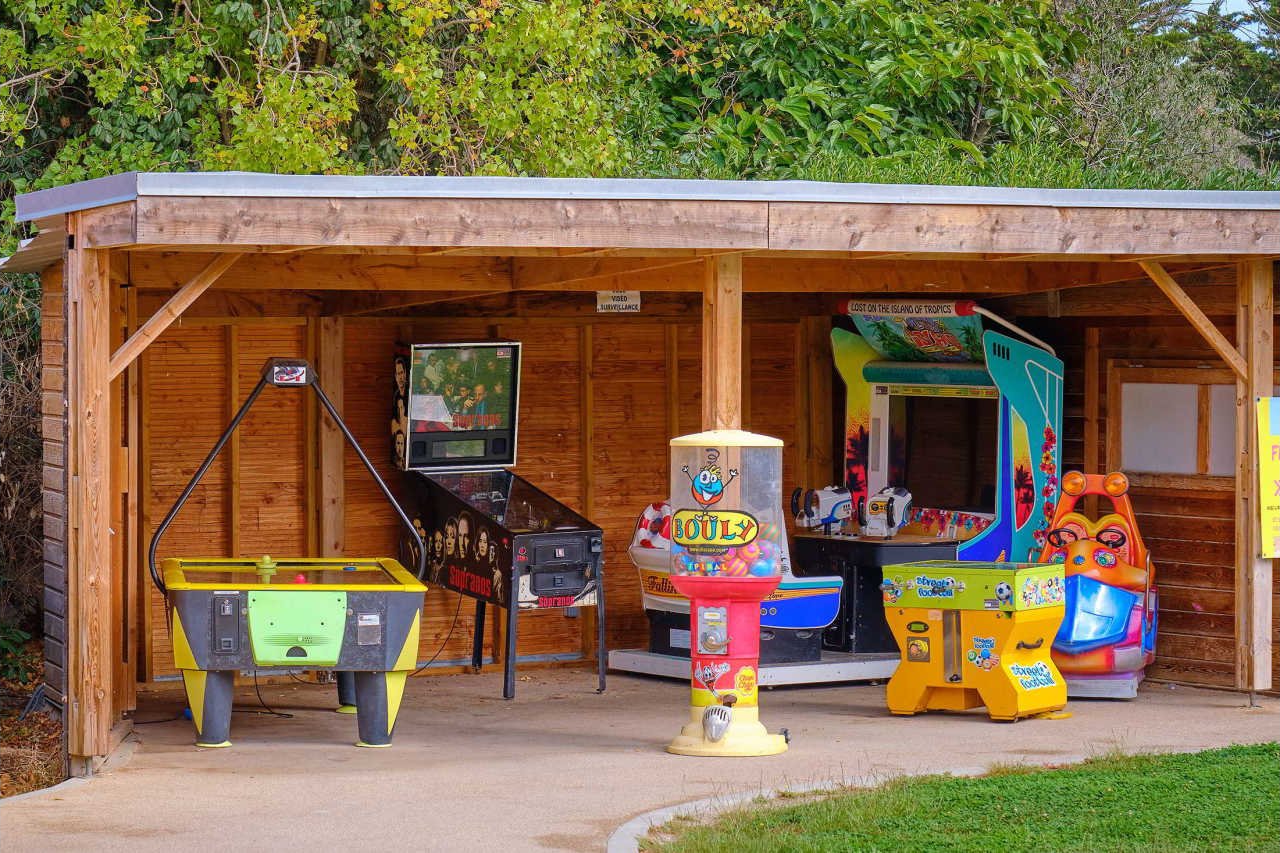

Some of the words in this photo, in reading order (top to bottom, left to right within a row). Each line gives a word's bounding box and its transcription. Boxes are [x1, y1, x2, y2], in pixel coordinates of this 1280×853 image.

[850, 302, 866, 312] LOST
[867, 302, 877, 312] ON
[878, 302, 890, 313] THE
[891, 303, 914, 314] ISLAND
[915, 304, 923, 314] OF
[923, 304, 952, 314] TROPICS
[674, 518, 755, 541] BOULY
